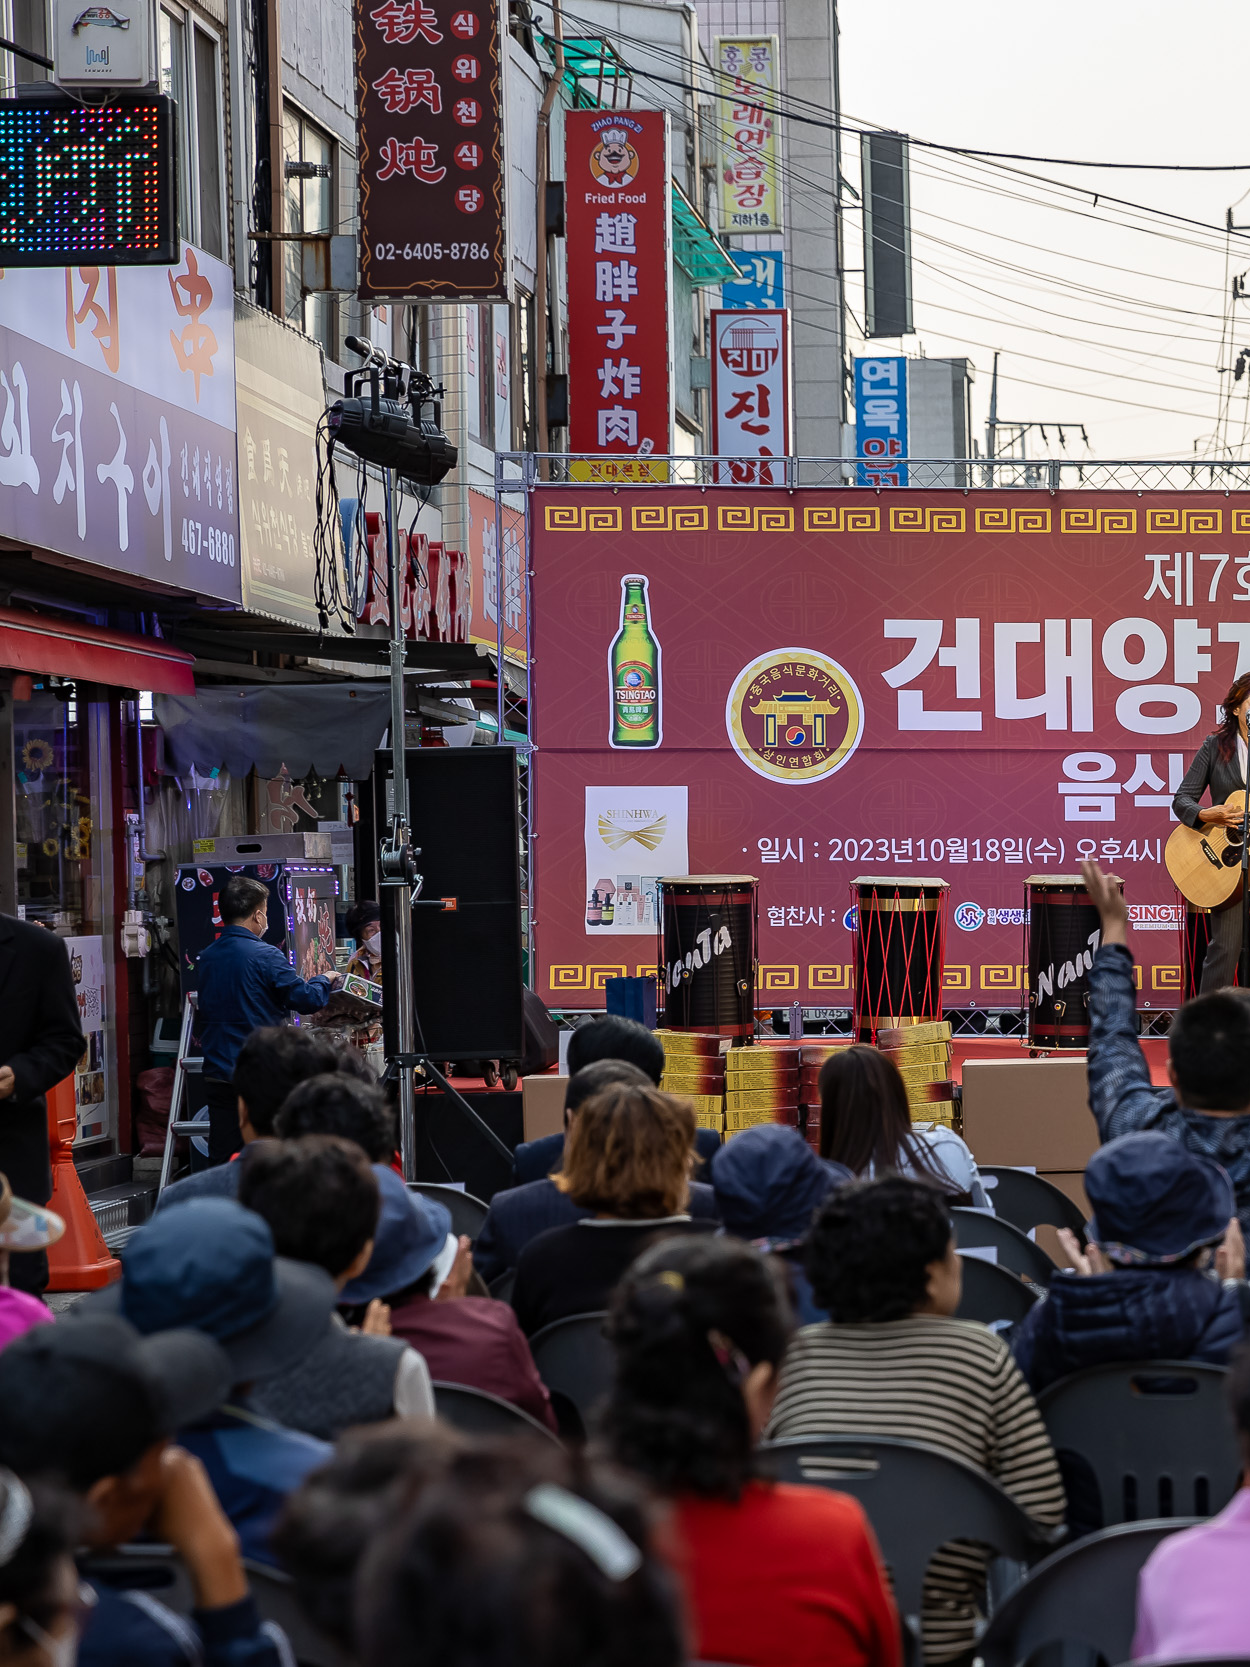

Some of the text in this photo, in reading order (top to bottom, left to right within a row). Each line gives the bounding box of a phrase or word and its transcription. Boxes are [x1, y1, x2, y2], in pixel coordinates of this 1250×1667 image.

[721, 46, 771, 73] 홍콩
[371, 0, 447, 184] 铁锅炖
[454, 14, 478, 212] 식위천식당
[590, 116, 644, 134] ZHAO PANG ZI
[731, 75, 768, 208] 노래연습장
[585, 193, 647, 204] Fried Food
[731, 213, 770, 227] 지하1층
[375, 243, 489, 261] 02-6405-8786
[594, 212, 641, 447] 趙胖子炸肉
[181, 518, 235, 568] 467-6880
[750, 665, 841, 698] 중국음식문화거리
[615, 690, 656, 700] TSINGTAO
[762, 748, 827, 768] 상인연합회
[606, 809, 658, 819] SHINHWA
[757, 837, 804, 863] 일시
[828, 836, 1065, 864] 2023년10월18일(수)
[1074, 837, 1161, 864] 오후4시
[767, 906, 825, 927] 협찬사
